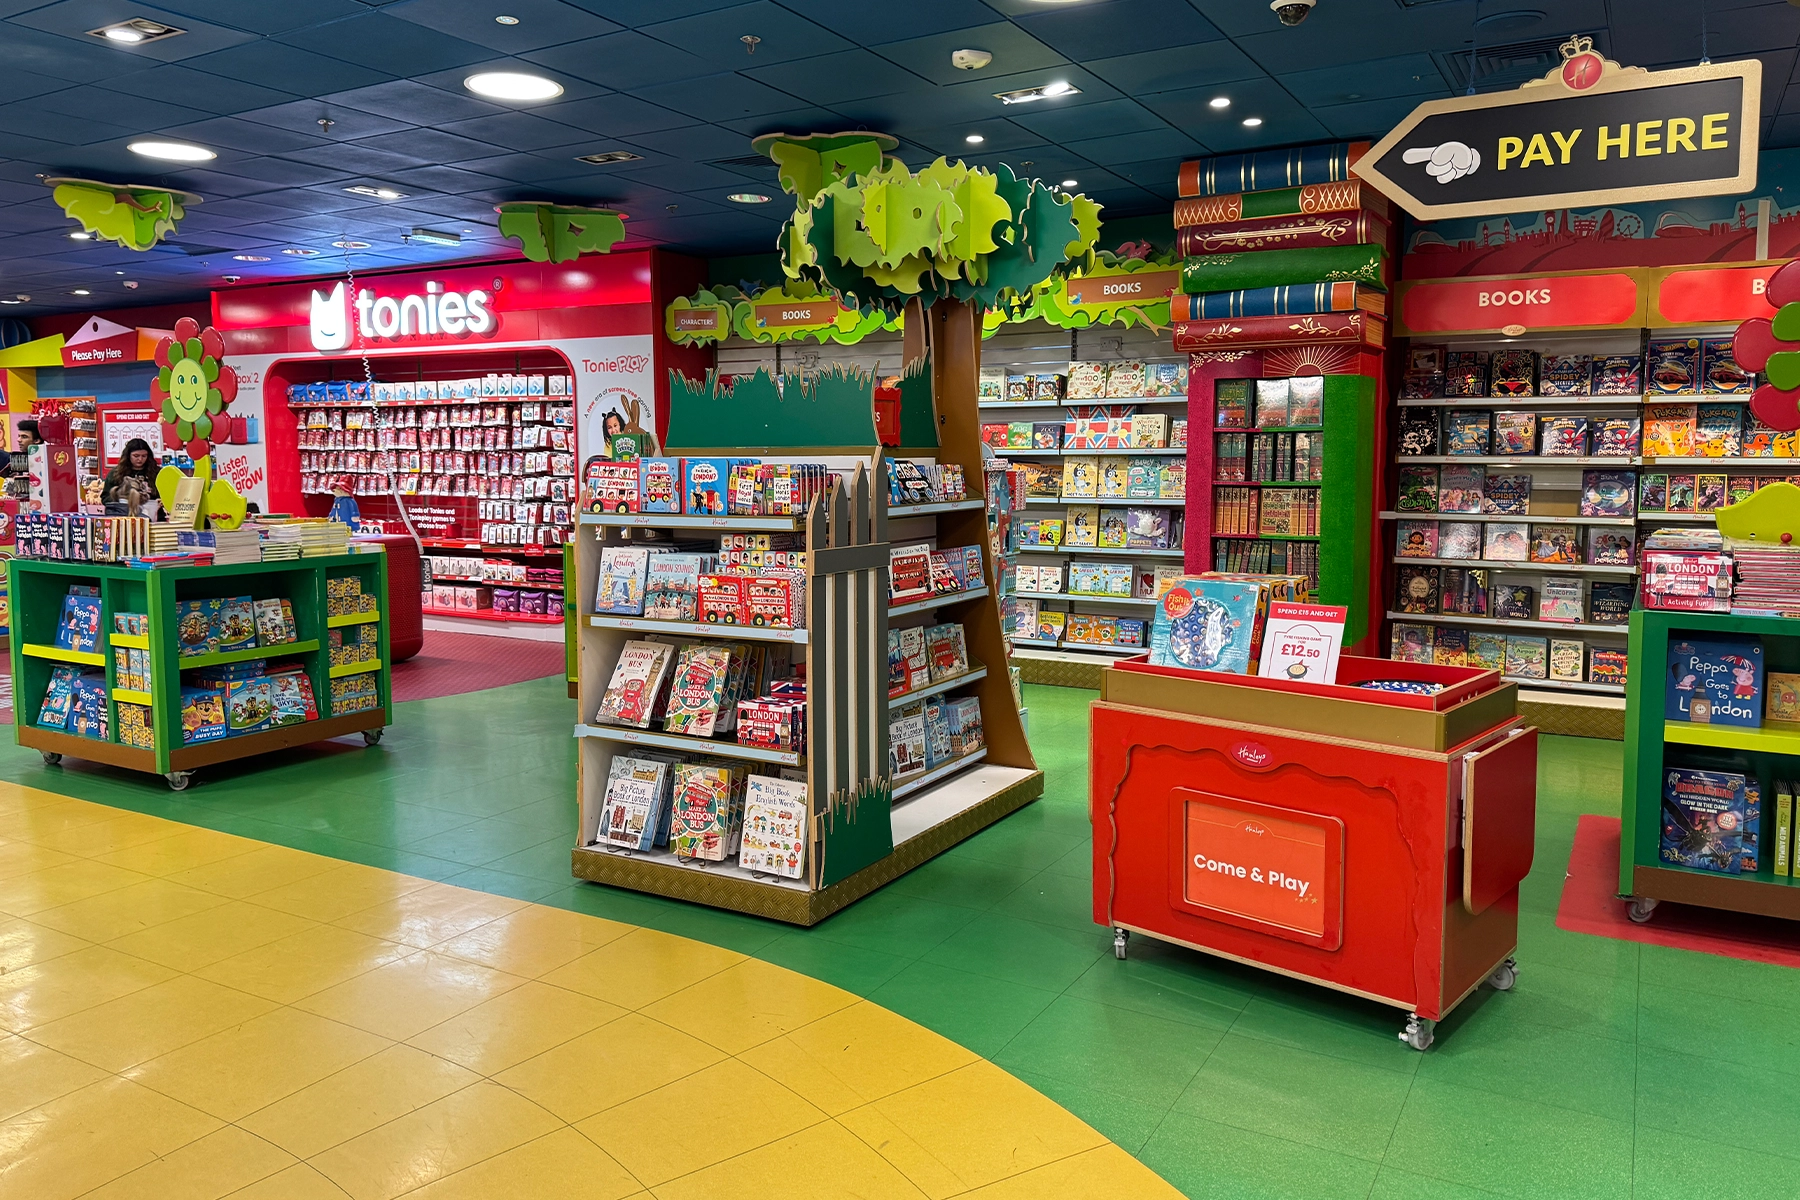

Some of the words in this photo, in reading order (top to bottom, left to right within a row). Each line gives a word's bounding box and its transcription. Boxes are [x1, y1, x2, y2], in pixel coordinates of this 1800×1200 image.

[1497, 129, 1582, 171] PAY
[1597, 112, 1730, 162] HERE
[1103, 282, 1142, 296] BOOKS
[1478, 288, 1551, 307] BOOKS
[355, 281, 490, 338] tonies
[782, 310, 811, 320] BOOKS
[680, 318, 713, 326] CHARACTERS
[72, 350, 92, 361] Please
[93, 349, 104, 361] Pay
[106, 348, 122, 359] Here
[1446, 366, 1484, 380] GIANT
[587, 401, 596, 413] new
[594, 393, 603, 402] era
[608, 386, 638, 399] screen-free
[637, 396, 652, 419] gaming
[1464, 424, 1478, 443] 5
[218, 455, 248, 476] Listen
[232, 466, 248, 483] play
[236, 466, 263, 494] grow
[693, 472, 717, 481] LONDON?
[613, 556, 636, 569] London
[653, 564, 674, 573] LONDON
[674, 564, 695, 574] SOUNDS
[1668, 564, 1714, 574] LONDON
[1168, 594, 1183, 603] Fish
[1668, 599, 1693, 608] Activity
[74, 606, 89, 620] Peppa
[1016, 612, 1026, 627] 2
[624, 651, 653, 660] LONDON
[1281, 643, 1320, 658] £12.50
[1690, 656, 1728, 677] Peppa
[1705, 679, 1729, 690] Goes
[80, 688, 96, 704] Peppa
[679, 688, 712, 699] LONDON
[1718, 691, 1728, 700] to
[748, 710, 779, 720] LONDON
[903, 722, 917, 730] Picture
[892, 733, 901, 741] Book
[1238, 746, 1266, 763] Hamleys
[619, 784, 629, 793] Big
[630, 786, 645, 796] Picture
[765, 786, 774, 794] Big
[776, 787, 791, 797] Book
[1676, 782, 1734, 799] DRAGON
[613, 791, 623, 799] Book
[624, 792, 631, 800] of
[632, 794, 649, 804] London
[756, 794, 778, 804] English
[779, 798, 796, 808] Words
[680, 810, 715, 822] LONDON
[690, 820, 704, 829] BUS
[1245, 824, 1264, 836] Hamleys
[1194, 854, 1246, 878] Come
[1251, 867, 1264, 884] &
[1268, 871, 1309, 897] Play
